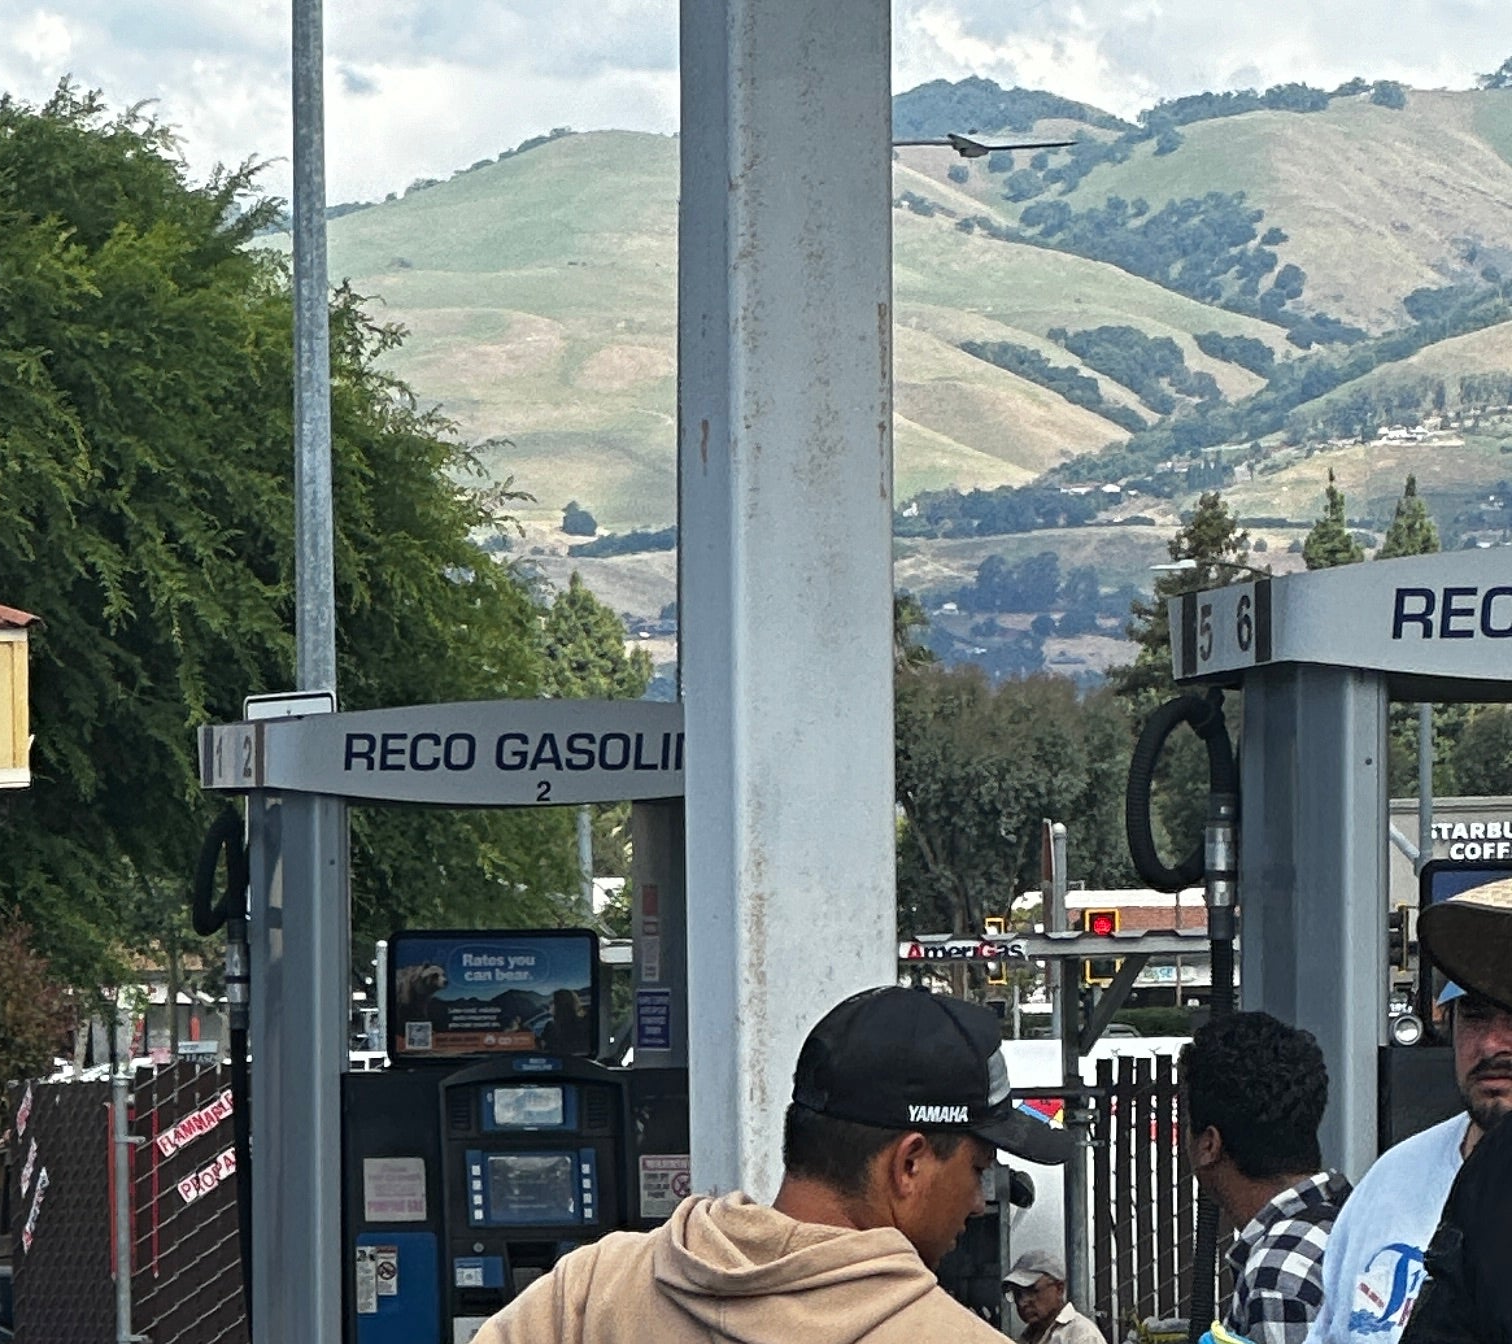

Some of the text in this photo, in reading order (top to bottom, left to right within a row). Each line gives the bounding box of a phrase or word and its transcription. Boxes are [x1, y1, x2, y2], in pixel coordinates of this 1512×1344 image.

[1199, 595, 1253, 662] 5 6
[216, 735, 252, 778] 1 2
[344, 732, 476, 772] RECO
[536, 780, 552, 802] 2
[1450, 842, 1511, 860] COFF
[462, 953, 536, 969] Rates you
[908, 940, 1025, 961] AmeriGas
[464, 970, 493, 981] can
[907, 1105, 969, 1122] YAMAHA
[180, 1150, 236, 1199] PROPA
